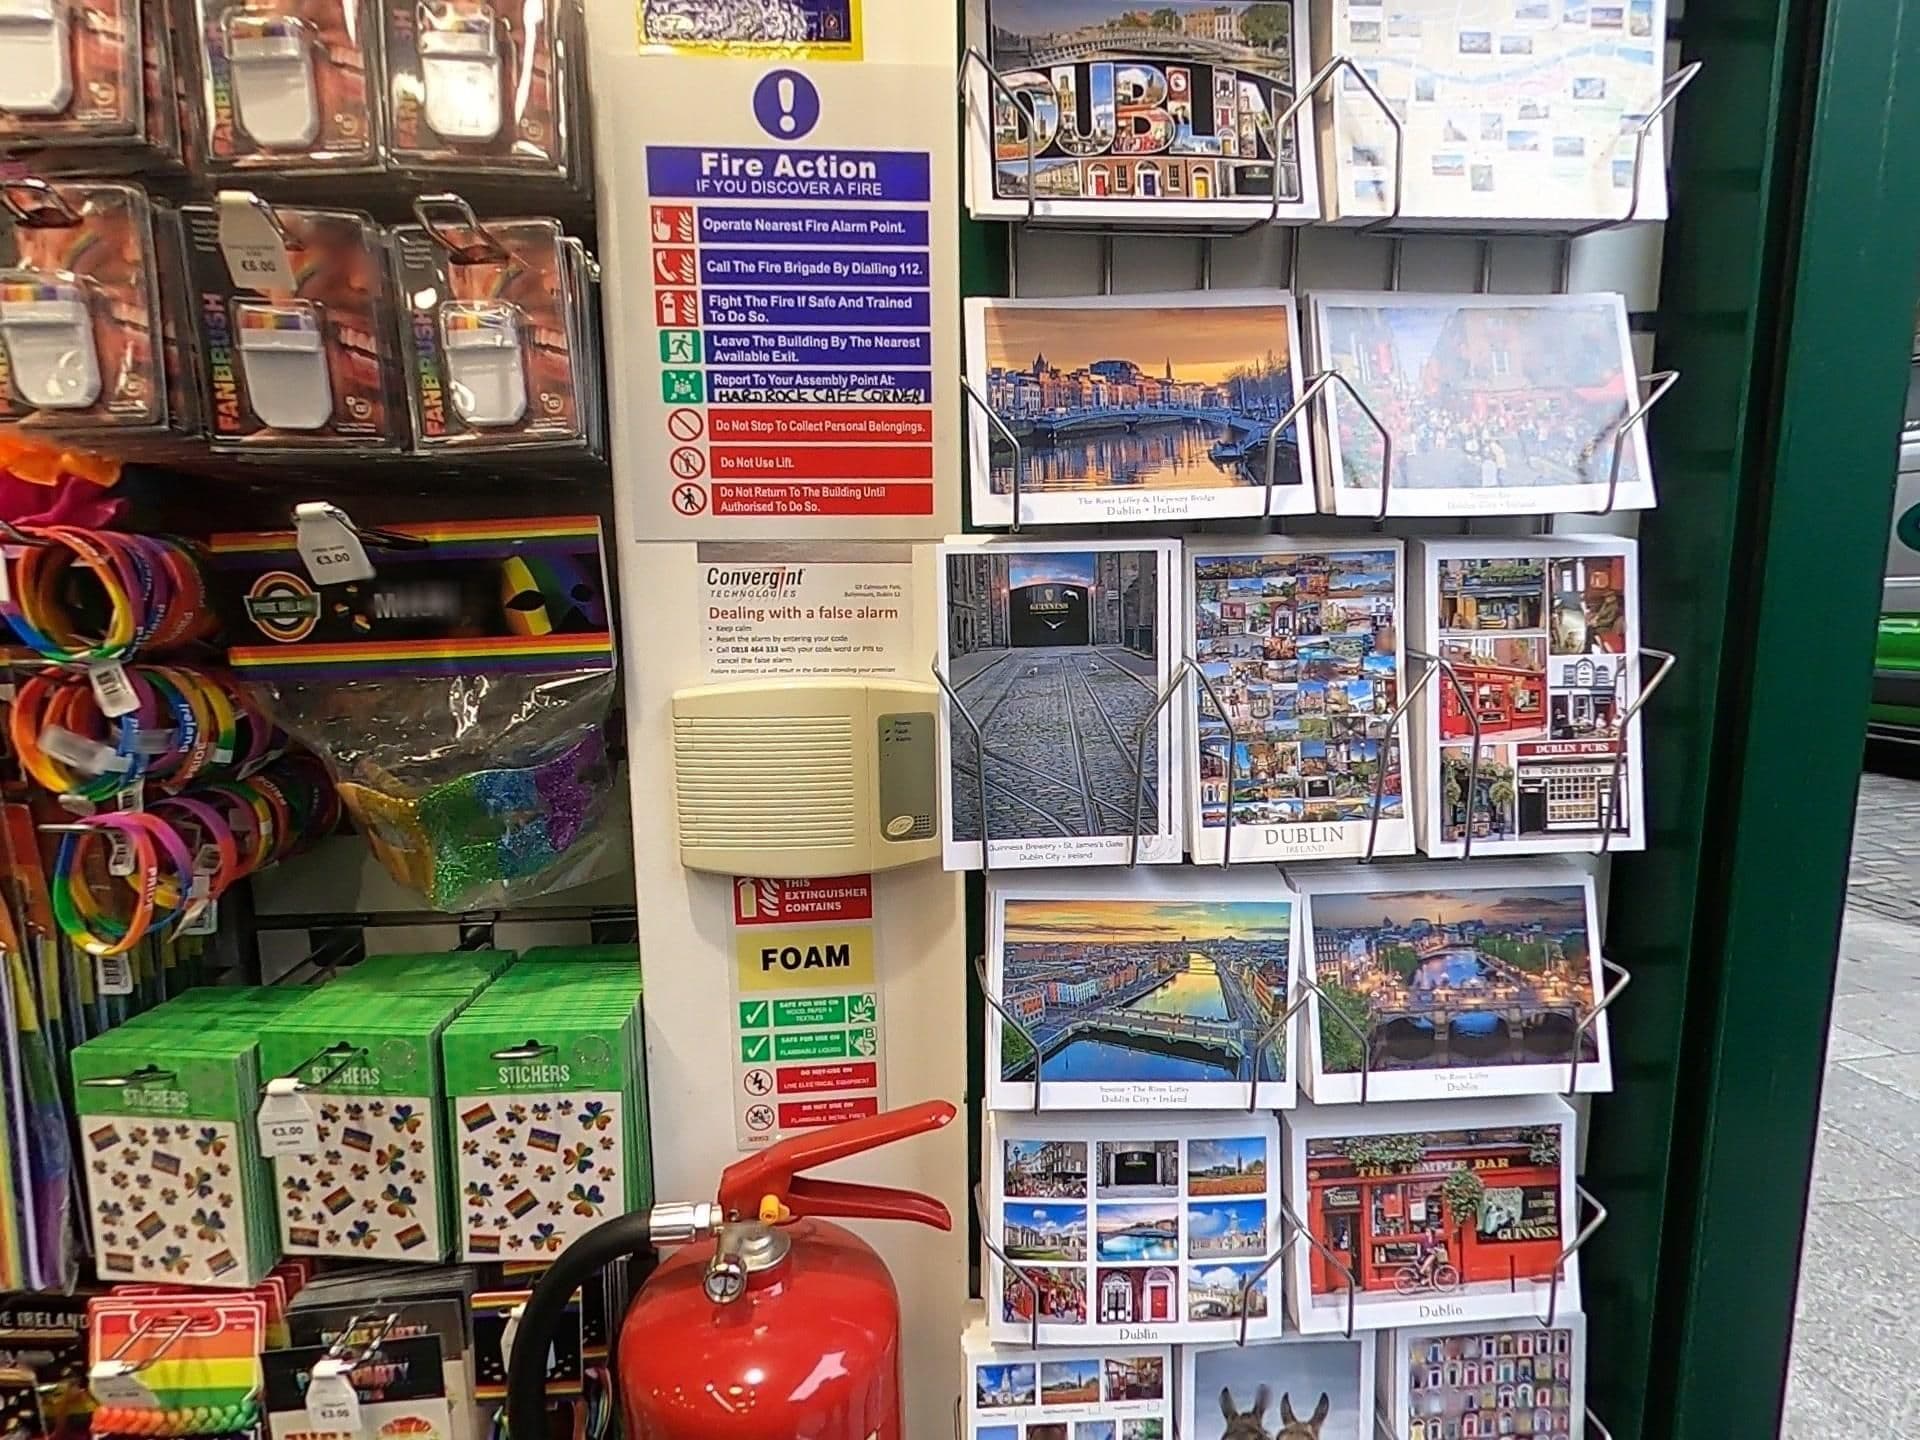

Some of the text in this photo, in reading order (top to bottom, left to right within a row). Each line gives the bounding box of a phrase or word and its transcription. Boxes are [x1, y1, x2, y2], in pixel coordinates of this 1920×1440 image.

[995, 62, 1294, 160] DUBLIN
[701, 153, 876, 179] Fire Action
[696, 181, 882, 196] IF YOU DISCOVER A FIRE
[703, 219, 905, 233] Operate Nearest Fire Alarm Point.
[707, 261, 923, 277] Call The Fire Brigade By Dialling 112.
[710, 296, 912, 308] Fight The Fire If Safe And Trained
[710, 311, 769, 323] To Do So.
[714, 336, 920, 350] Leave The Building By The Nearest
[714, 351, 799, 362] Available Exit.
[714, 374, 895, 388] Report To Your Assembly Point At:
[716, 421, 925, 433] Do Not Stop To Collect Personal Belongings.
[721, 458, 794, 468] Do Not Use Lift.
[720, 487, 885, 499] Do Not Return To The Building Until
[721, 502, 820, 512] Authorised To Do So.
[1107, 505, 1188, 516] Dublin Ireland
[707, 567, 804, 589] Convergint
[710, 590, 797, 598] TECHNOLOGIES
[709, 607, 898, 621] Dealing with a false alarm
[1536, 743, 1609, 753] DUBLIN PUBS
[1265, 826, 1344, 844] DUBLIN
[1286, 845, 1324, 853] IRELAND
[785, 880, 810, 888] THIS
[785, 888, 867, 900] EXTINGUISHER
[786, 902, 841, 912] CONTAINS
[762, 944, 849, 970] FOAM
[864, 996, 873, 1005] A
[865, 1028, 873, 1038] B
[1133, 1095, 1149, 1104] City
[1356, 1158, 1510, 1177] THE TEMPLE BAR
[1497, 1226, 1558, 1240] GUINNESS
[1420, 1304, 1462, 1317] Dublin
[1120, 1328, 1158, 1340] Dublin
